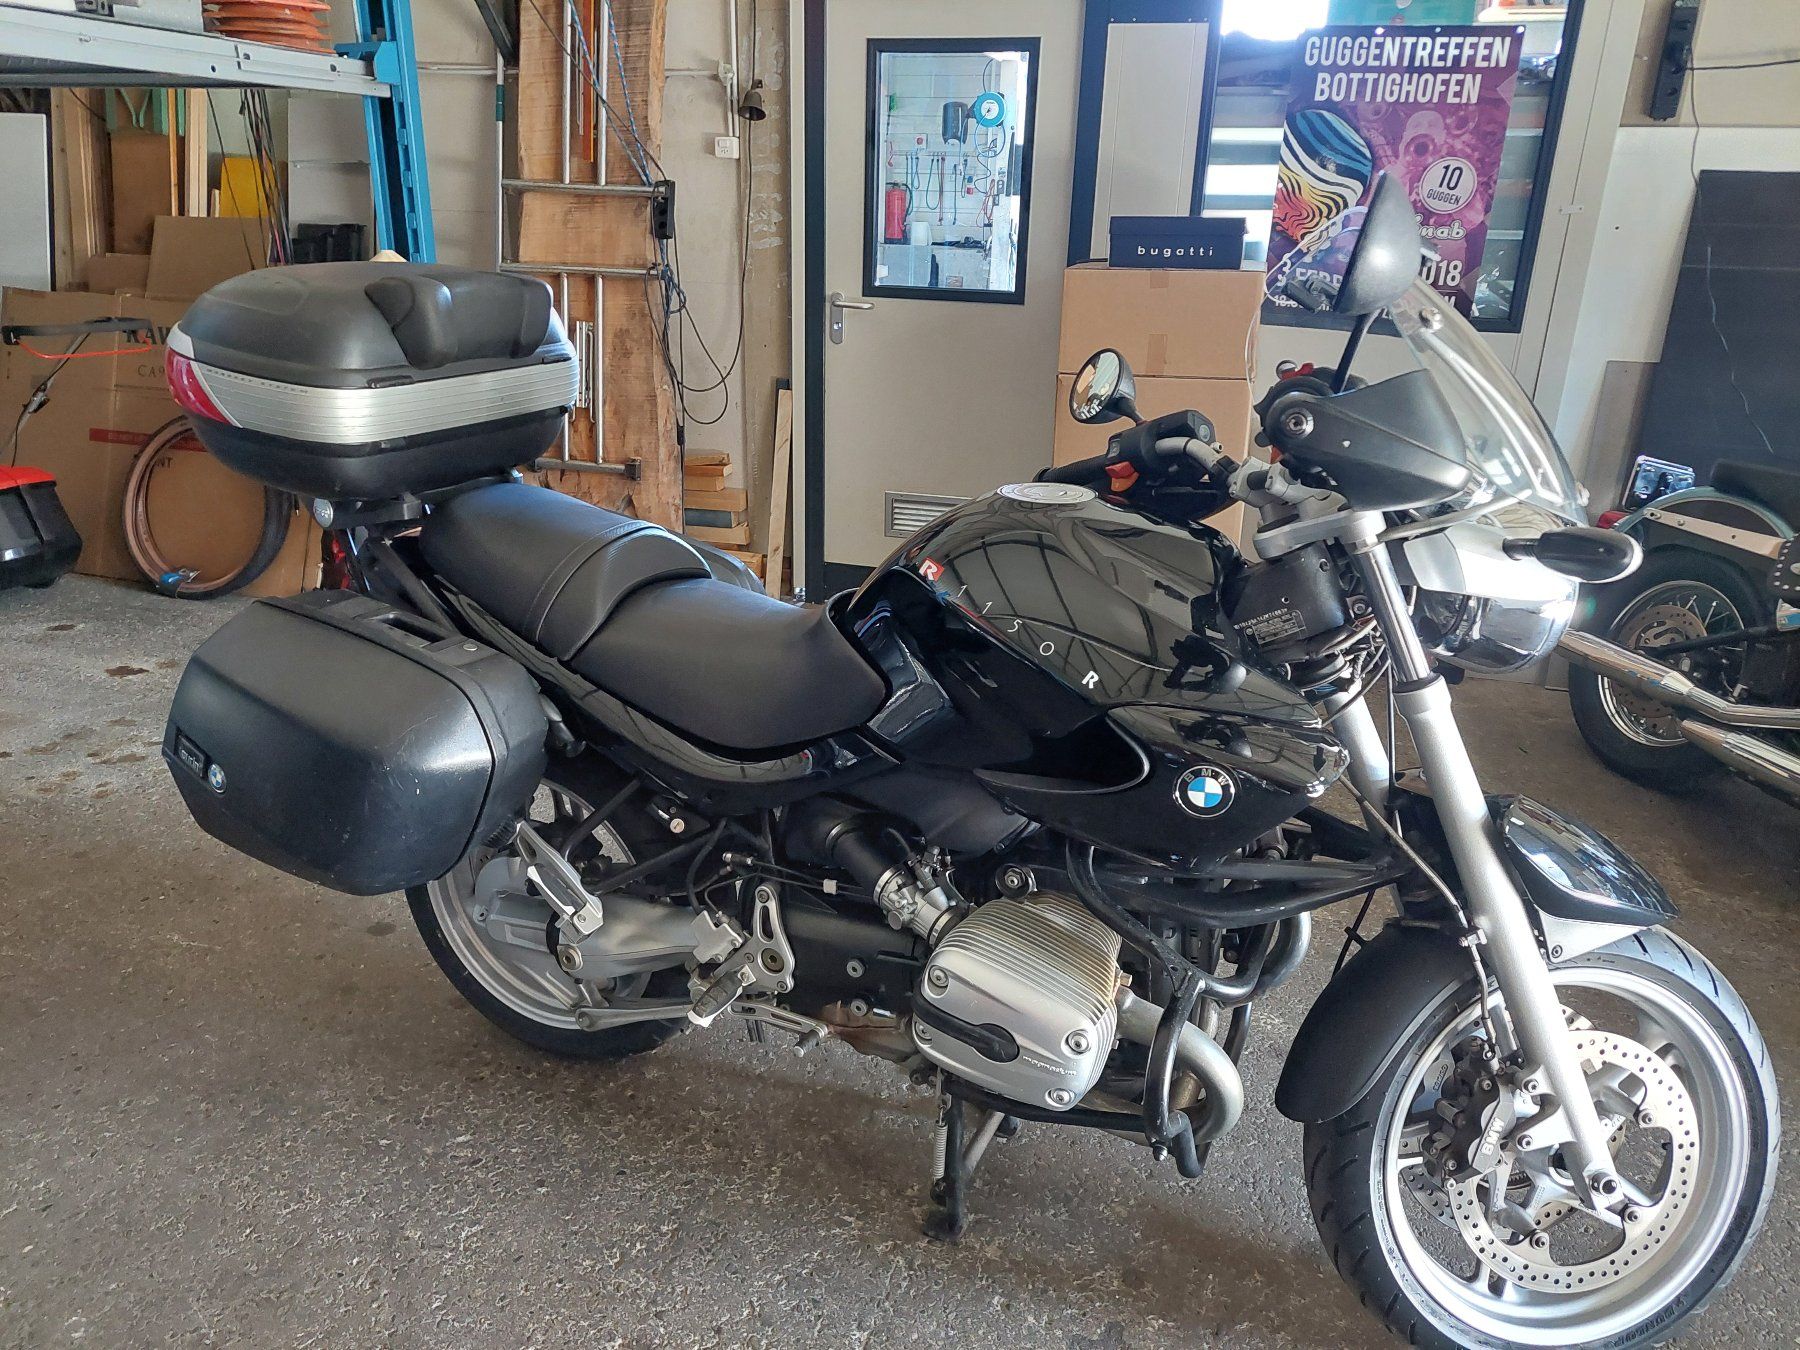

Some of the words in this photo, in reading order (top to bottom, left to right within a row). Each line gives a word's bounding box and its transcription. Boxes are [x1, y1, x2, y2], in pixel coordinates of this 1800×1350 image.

[1304, 36, 1511, 68] GUGGENTREFFEN
[1314, 72, 1482, 104] BOTTIGHOFEN
[1438, 164, 1463, 191] 10
[1426, 188, 1462, 205] GUGGEN
[1137, 245, 1213, 257] bugatti
[1421, 260, 1463, 287] 018
[1081, 670, 1100, 689] R
[1183, 768, 1231, 786] BMW
[1481, 1117, 1505, 1156] BMW
